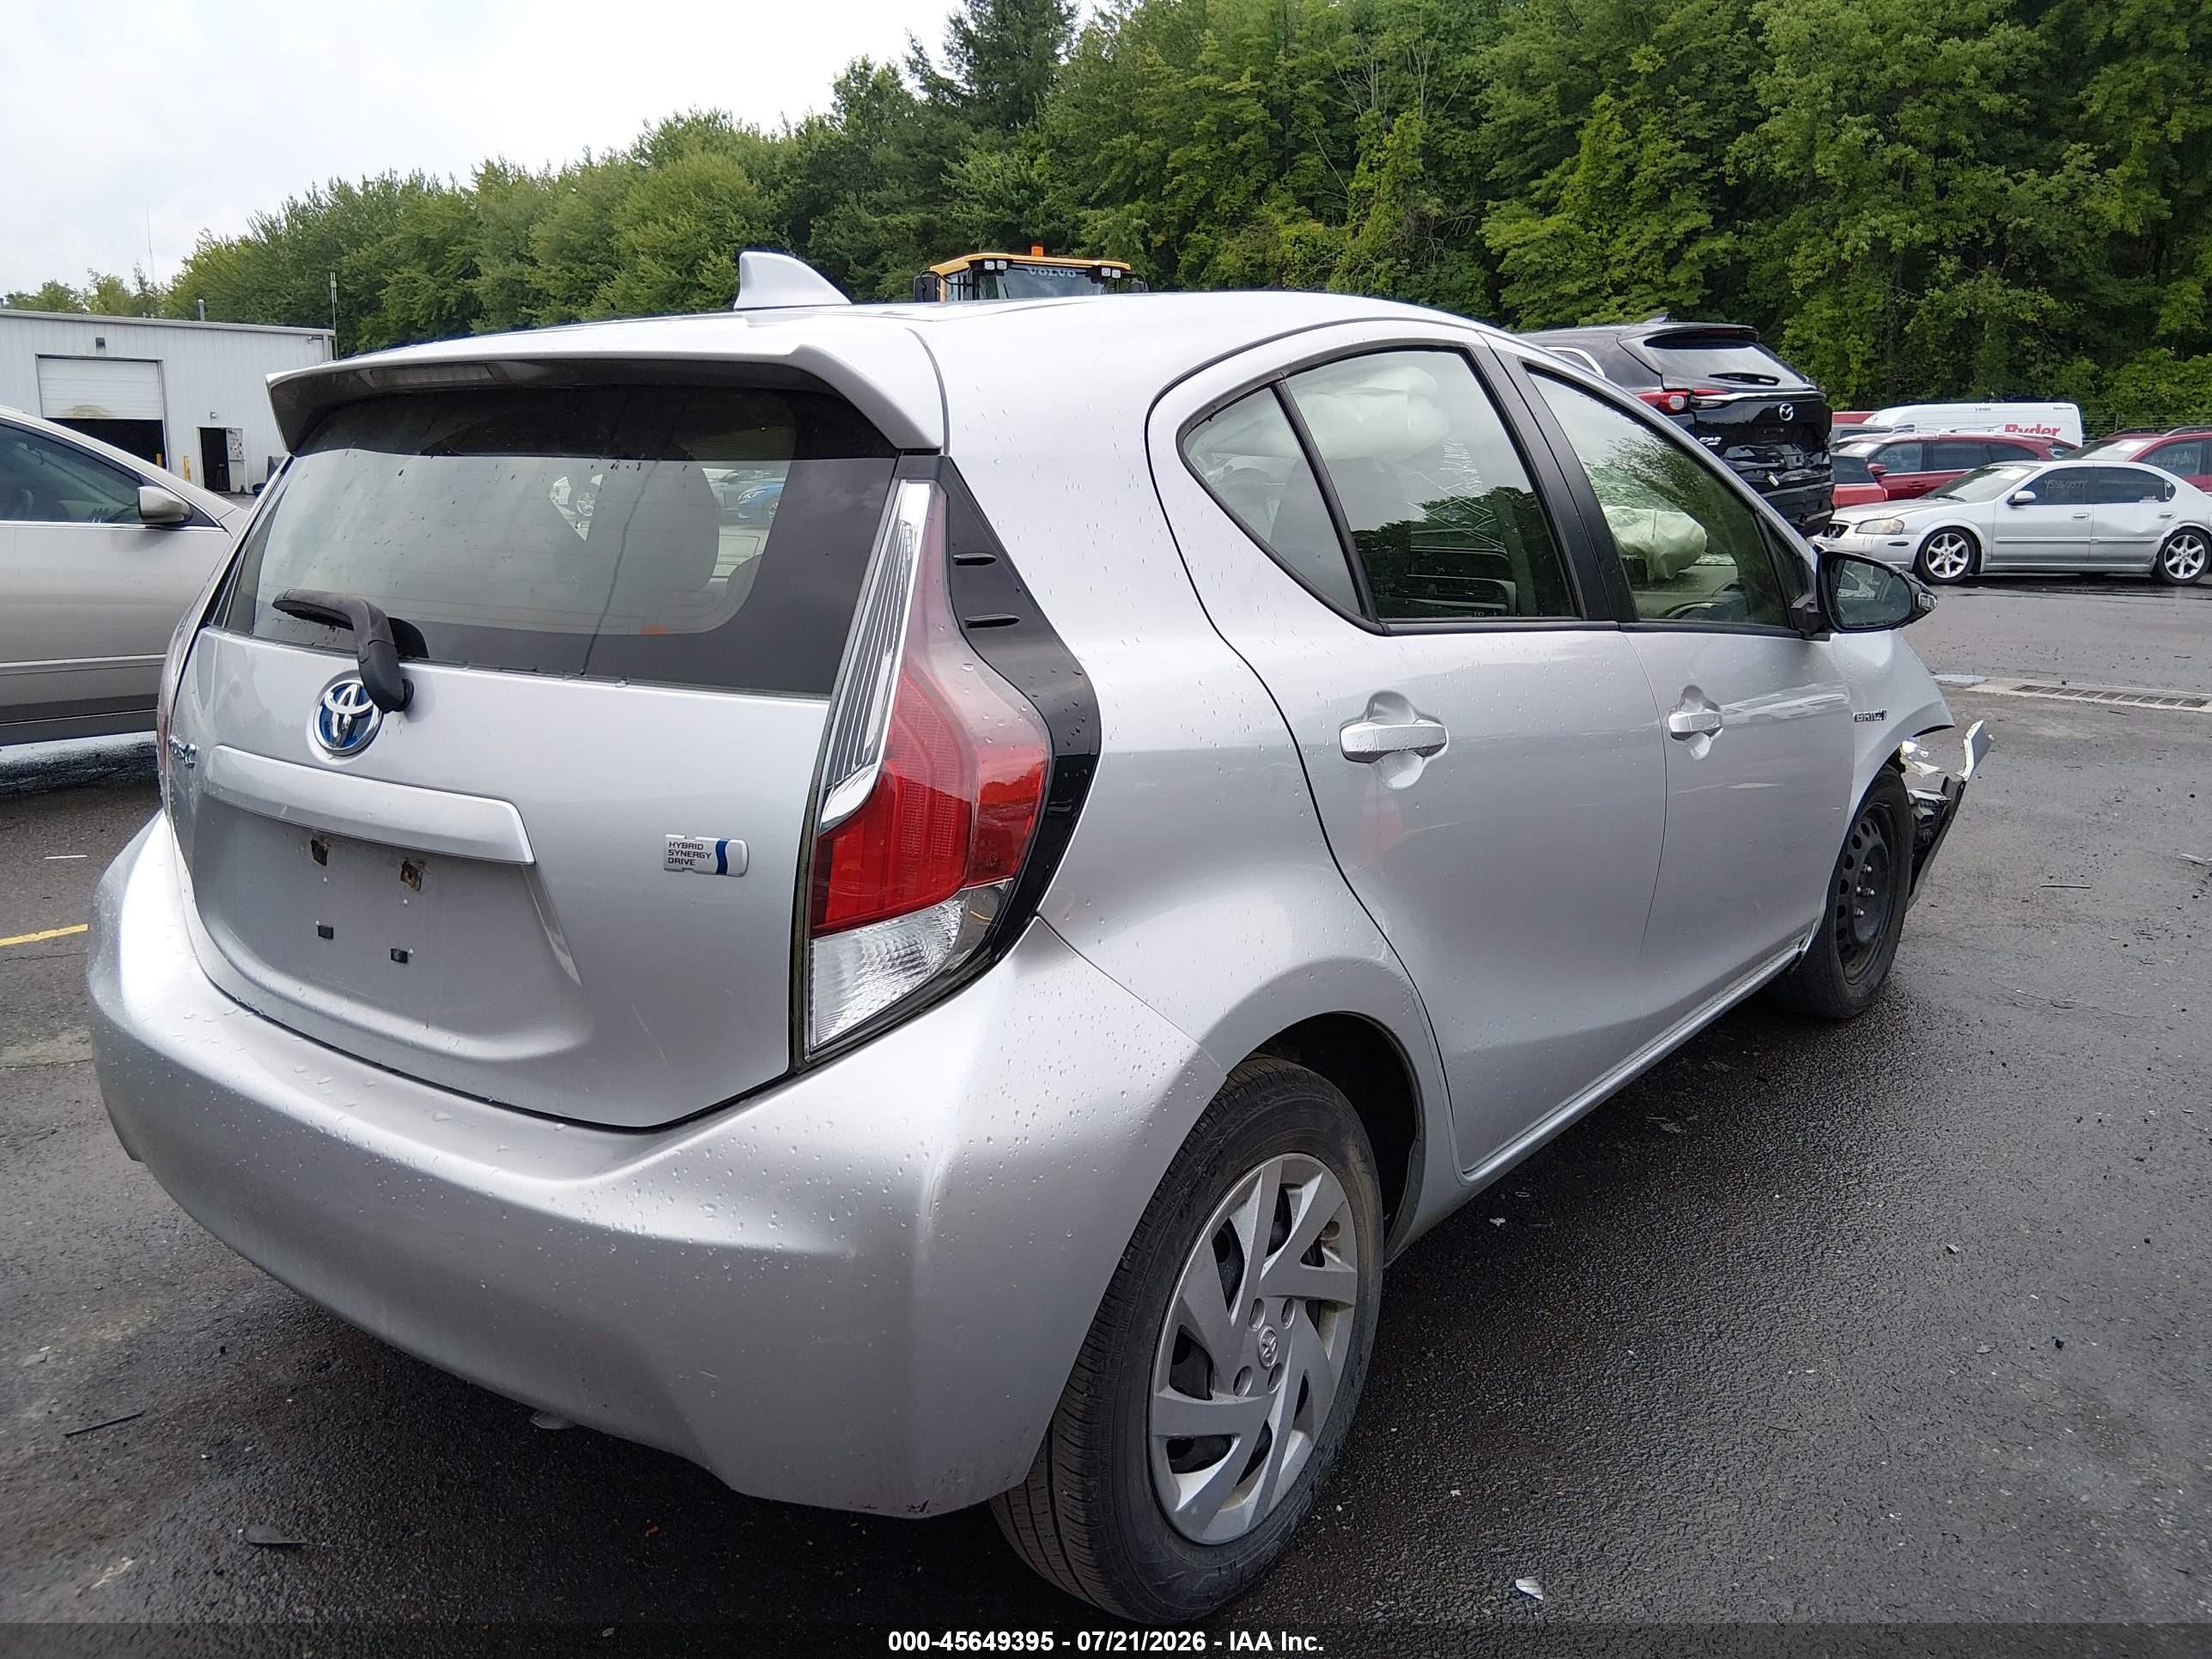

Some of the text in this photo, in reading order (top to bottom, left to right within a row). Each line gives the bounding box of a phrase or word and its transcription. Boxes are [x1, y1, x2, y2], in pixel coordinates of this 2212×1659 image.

[1027, 267, 1076, 277] VOLVO
[668, 841, 703, 850] HYBRID
[667, 848, 712, 859] SYNERGY
[667, 857, 695, 866] DRIVE
